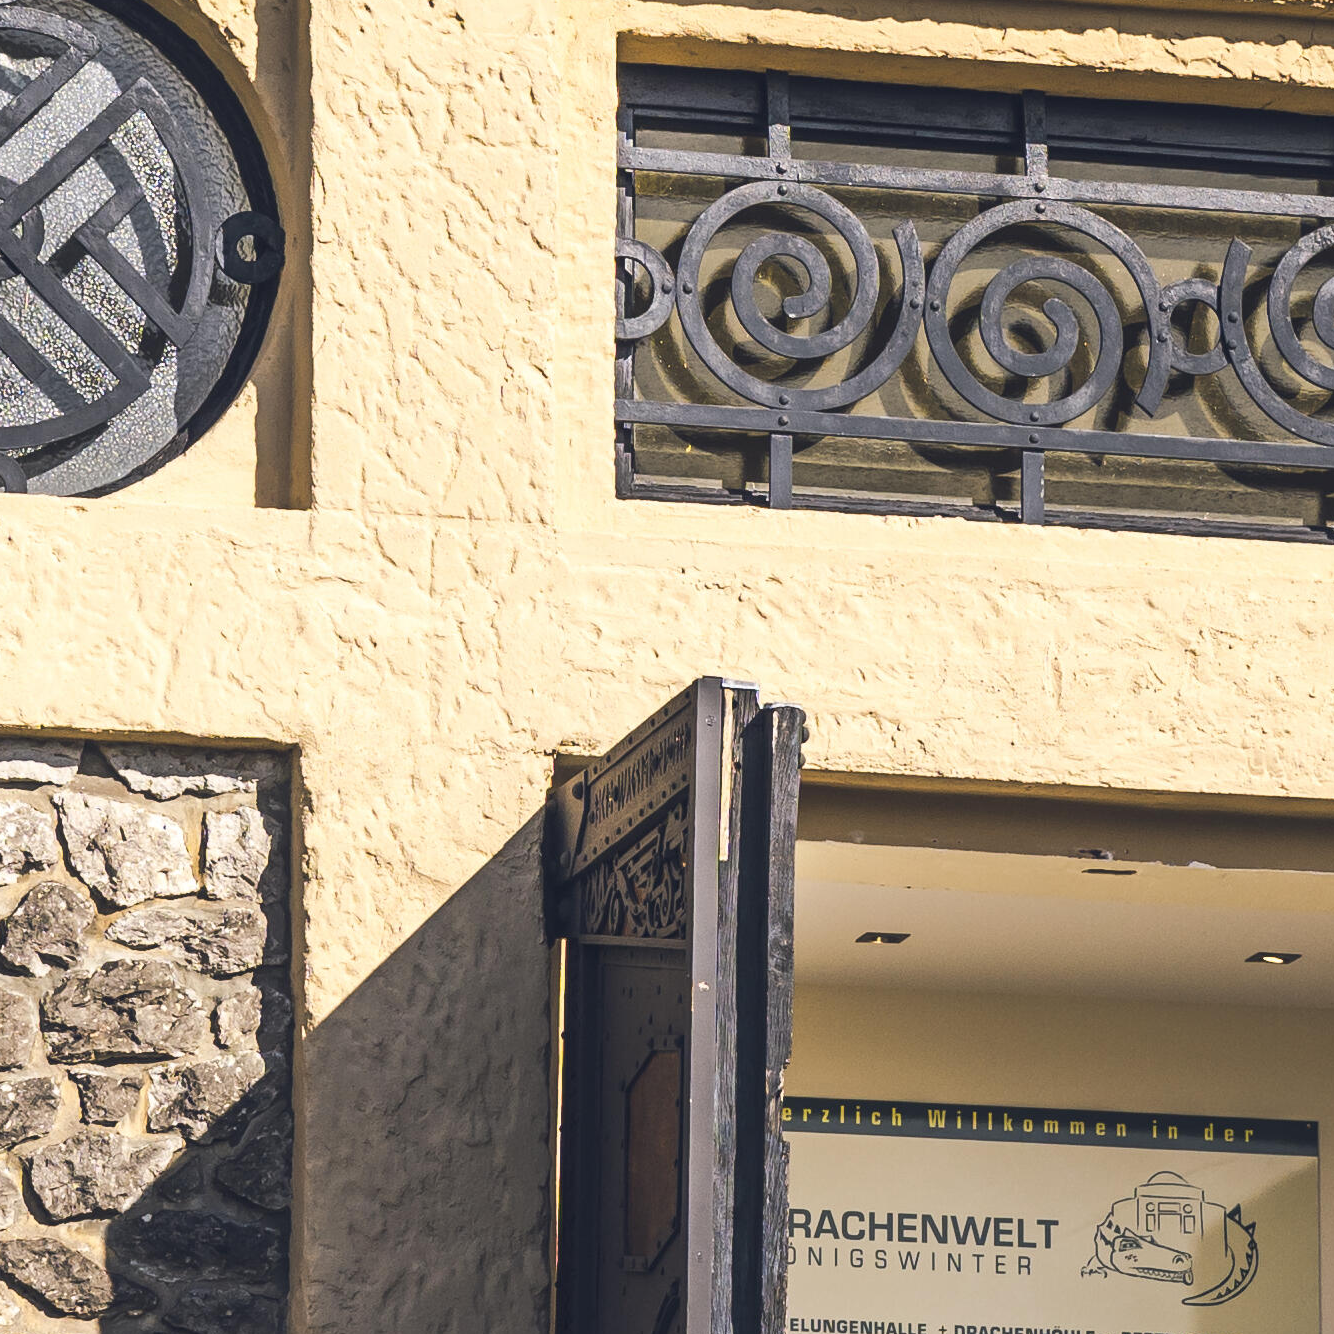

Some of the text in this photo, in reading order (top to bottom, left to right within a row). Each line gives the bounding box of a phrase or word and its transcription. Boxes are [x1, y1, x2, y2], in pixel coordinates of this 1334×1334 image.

[782, 1105, 1253, 1142] erzlich Willkommen in der
[788, 1208, 1059, 1249] RACHENWELT
[786, 1242, 1031, 1276] ÖNIGSWINTER
